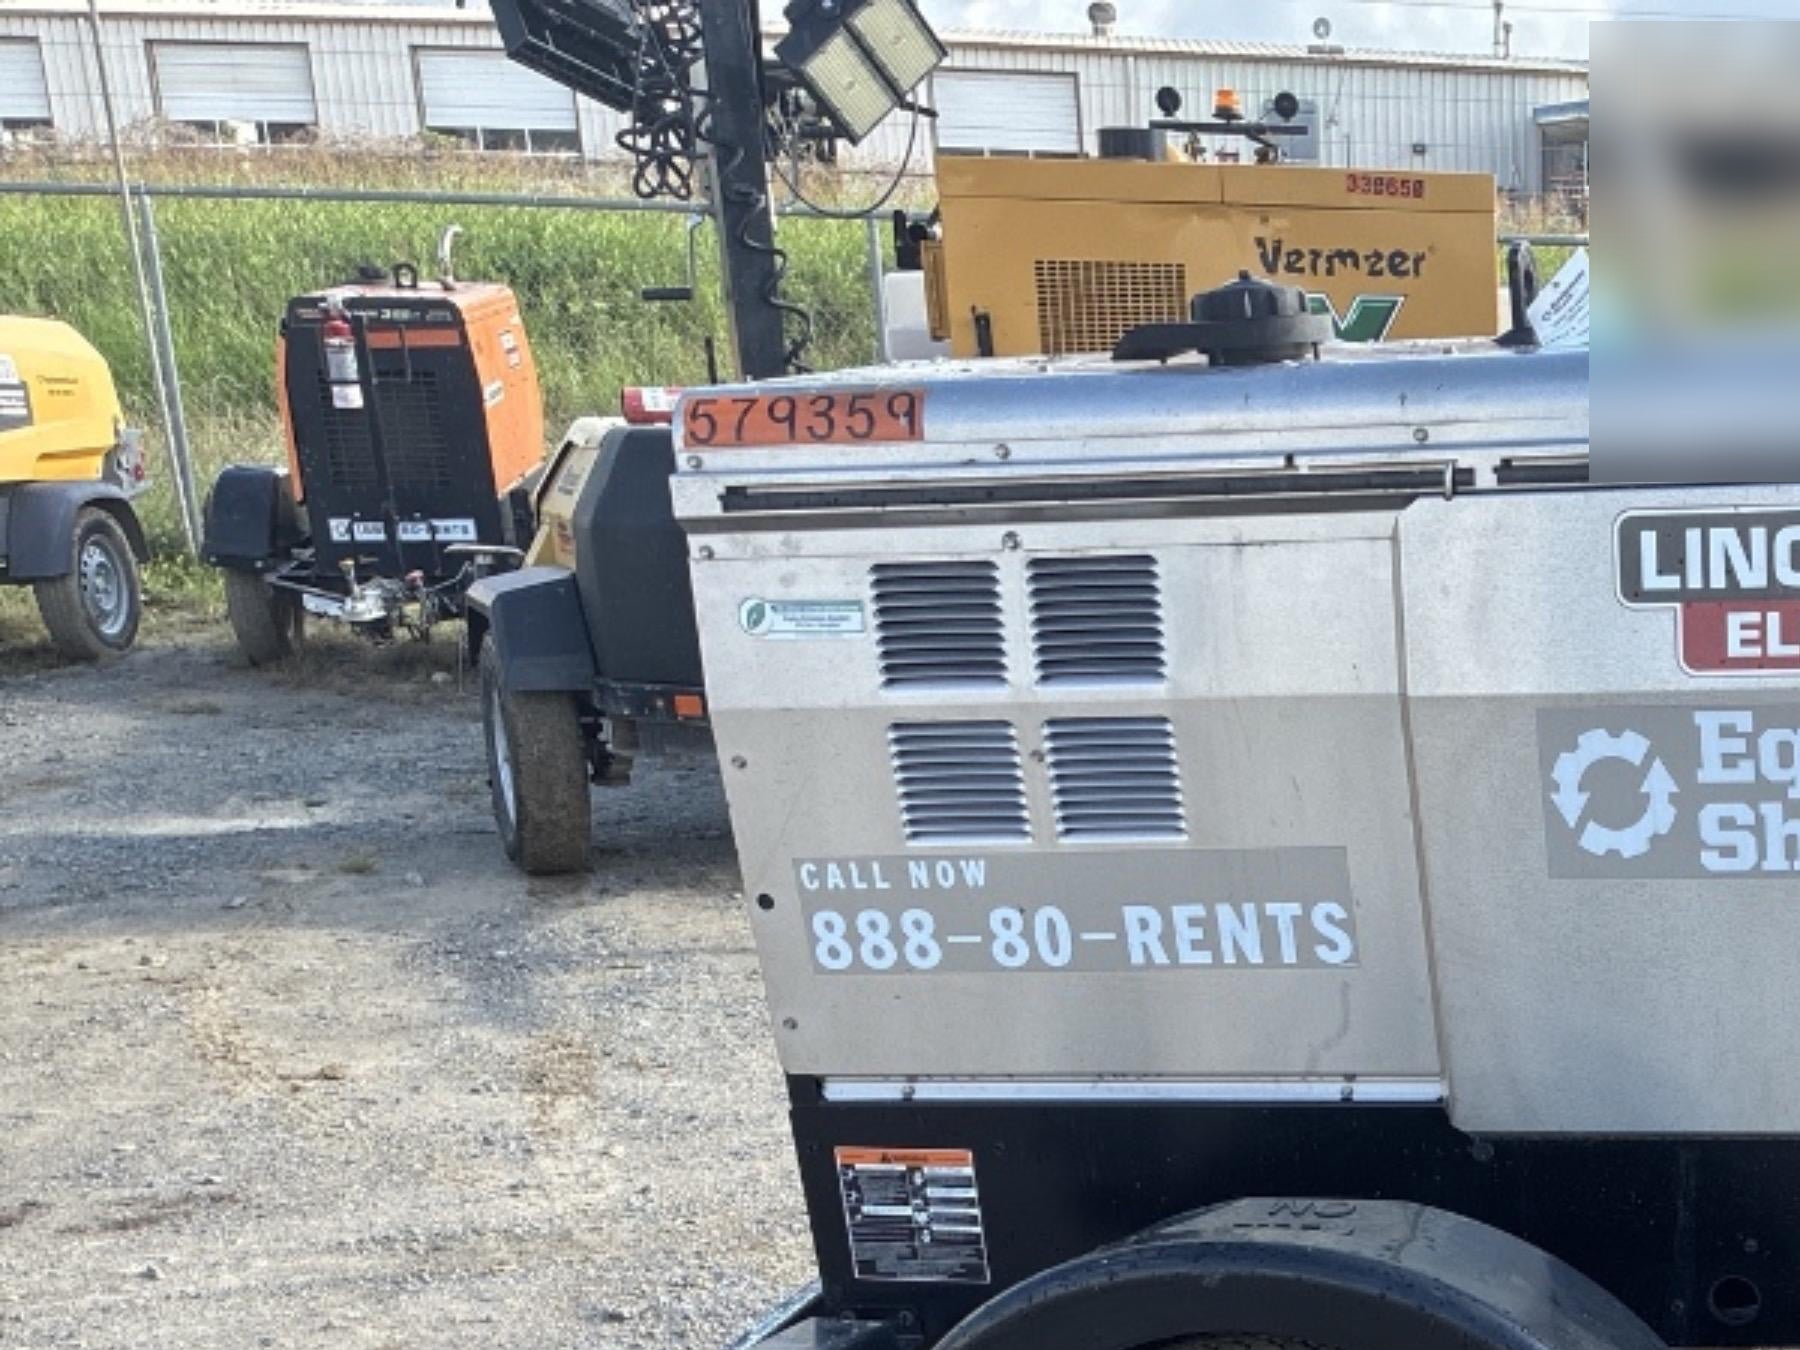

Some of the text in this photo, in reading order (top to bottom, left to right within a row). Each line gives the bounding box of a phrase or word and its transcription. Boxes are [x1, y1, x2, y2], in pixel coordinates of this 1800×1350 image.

[689, 391, 917, 444] 579359
[800, 859, 987, 890] CALL NOW
[812, 902, 1354, 970] 888-80-RENTS
